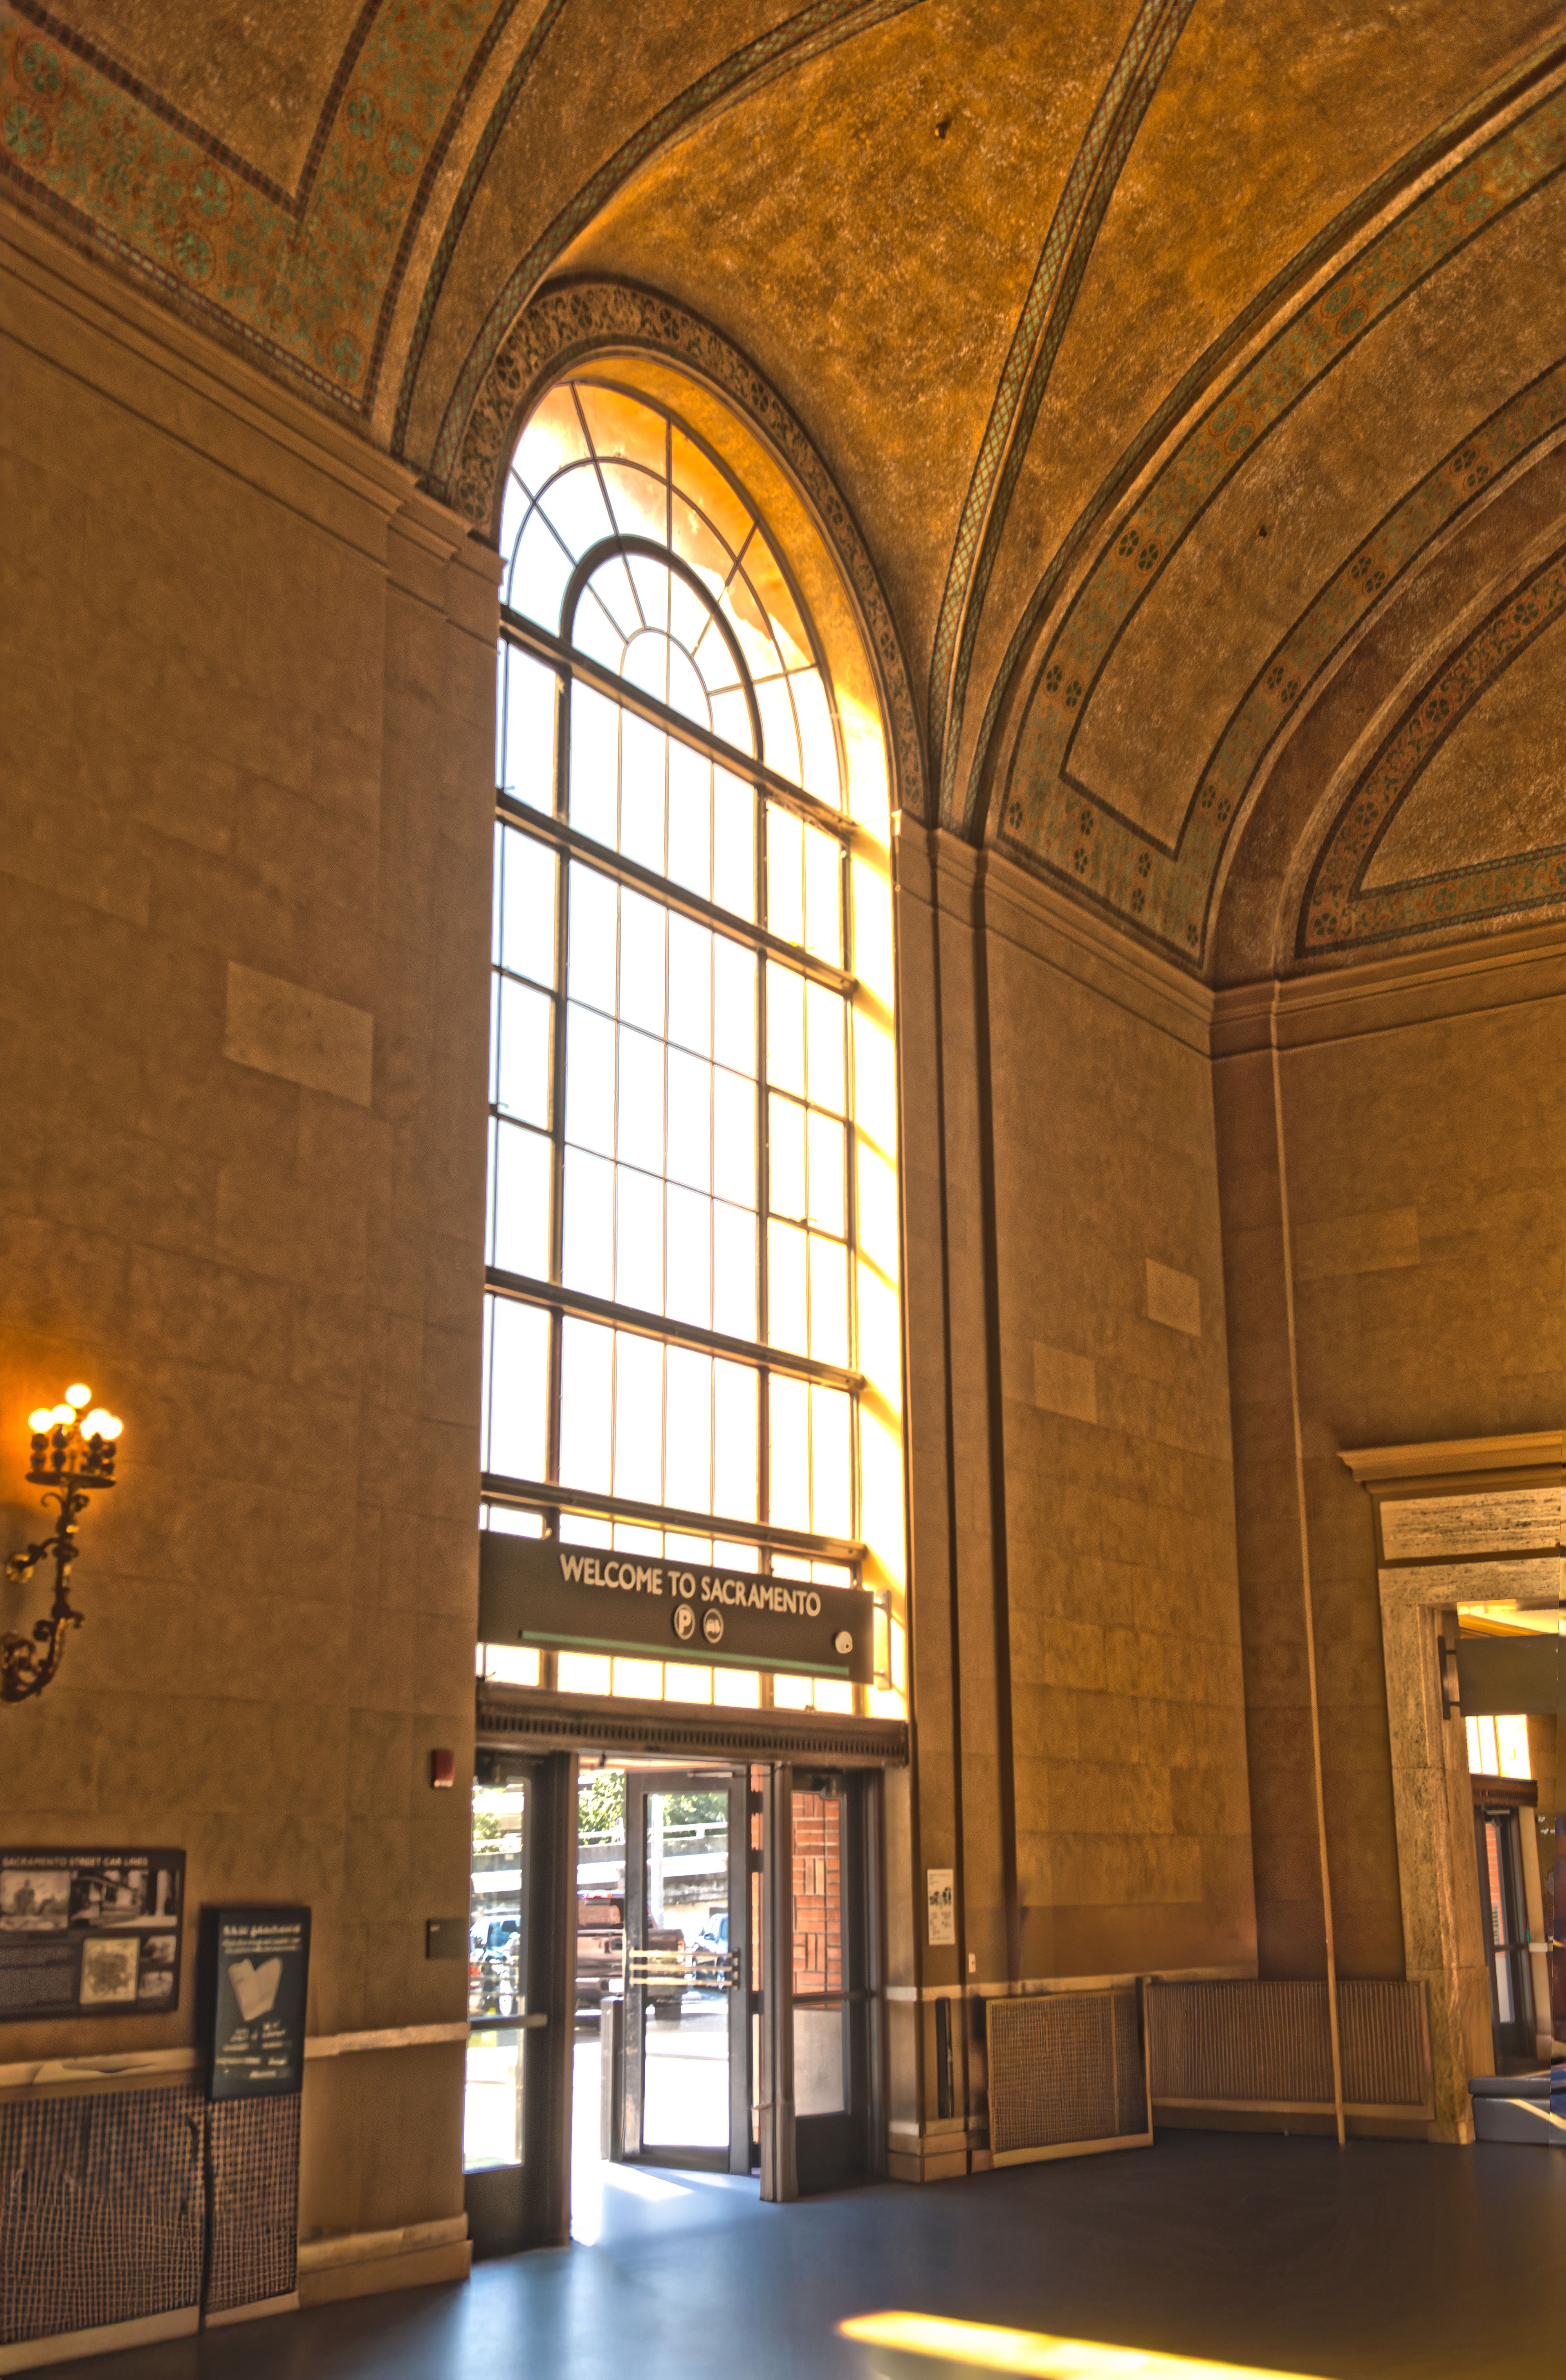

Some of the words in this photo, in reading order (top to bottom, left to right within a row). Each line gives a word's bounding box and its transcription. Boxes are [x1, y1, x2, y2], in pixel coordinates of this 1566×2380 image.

[560, 1553, 663, 1595] WELCOME
[668, 1570, 696, 1598] TO
[701, 1575, 821, 1616] SACRAMENTO
[678, 1608, 691, 1635] P
